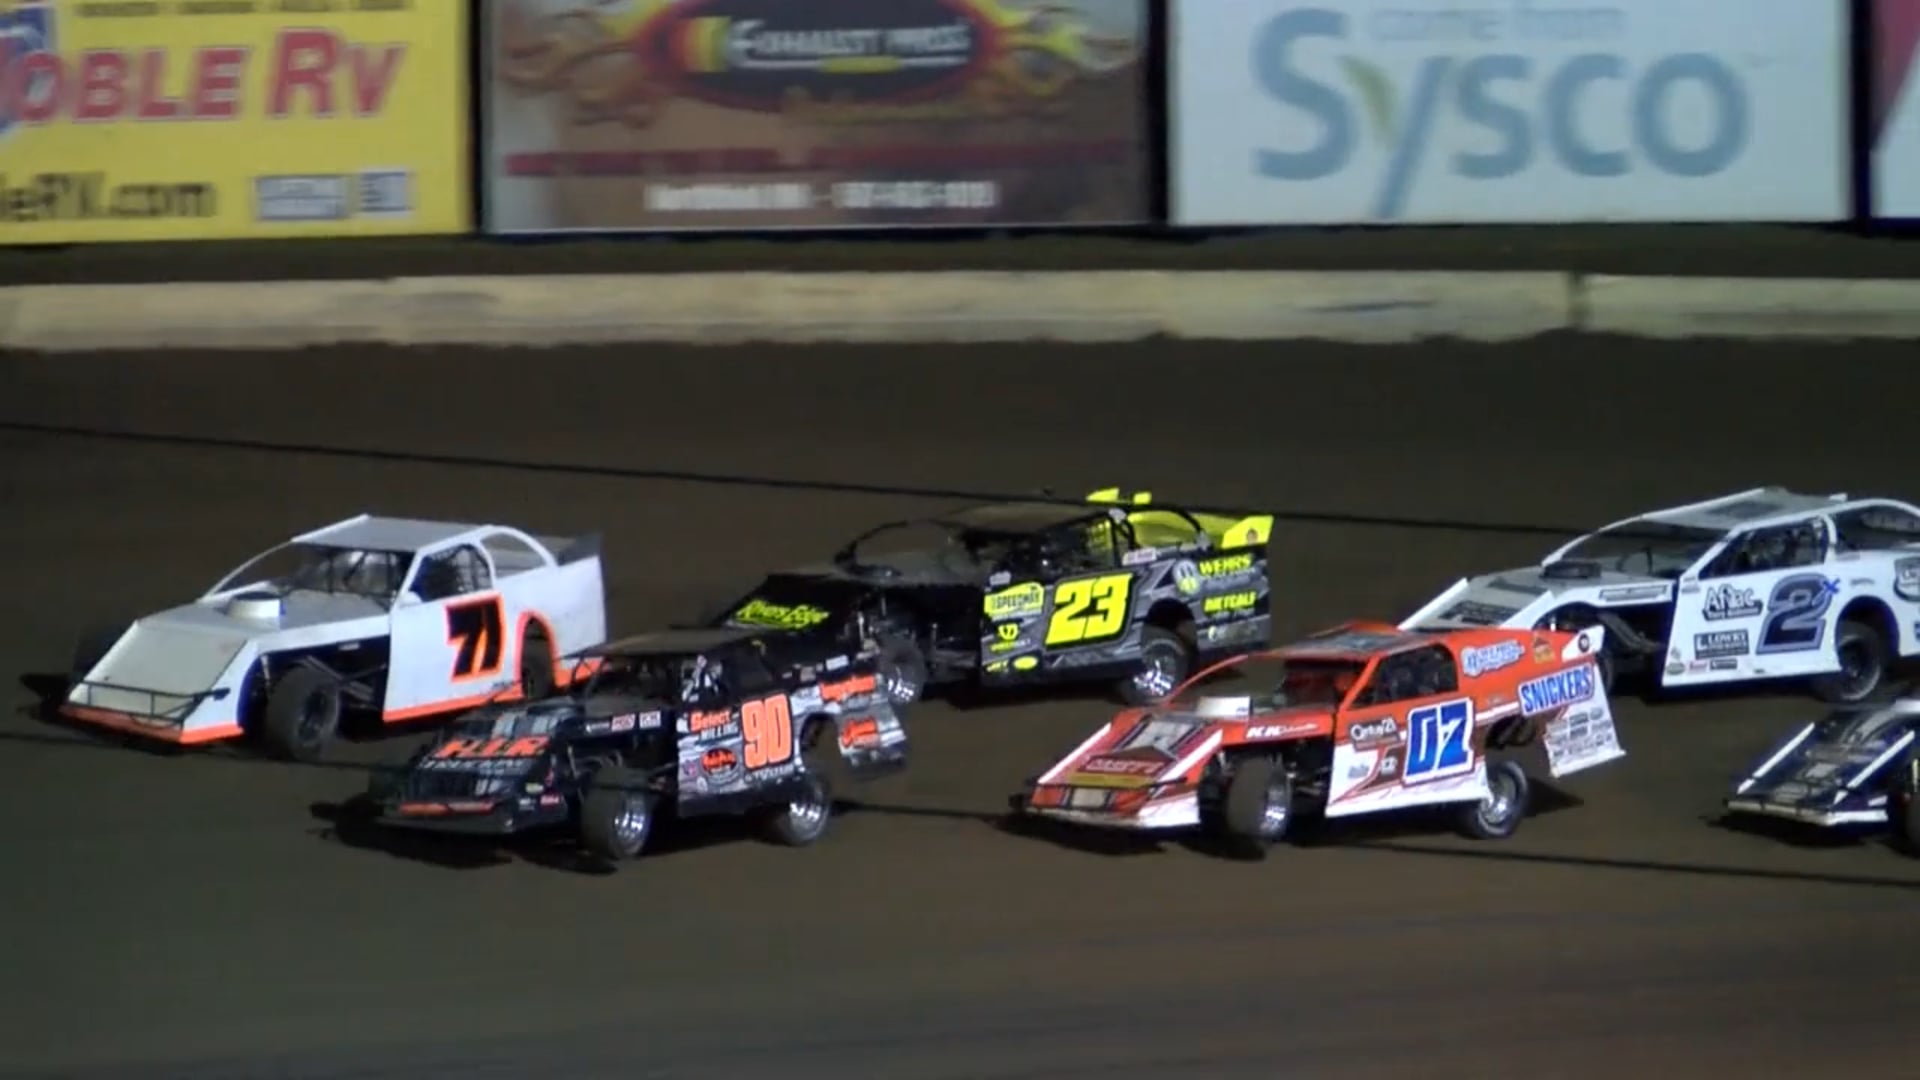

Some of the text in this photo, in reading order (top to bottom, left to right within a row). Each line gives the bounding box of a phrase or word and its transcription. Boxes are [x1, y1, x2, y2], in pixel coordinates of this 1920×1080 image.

[1251, 7, 1751, 218] Sysco
[446, 595, 505, 682] 71
[1045, 572, 1133, 645] 23
[1520, 667, 1593, 714] SNICKERS
[741, 693, 792, 769] 90
[1403, 699, 1472, 781] 07
